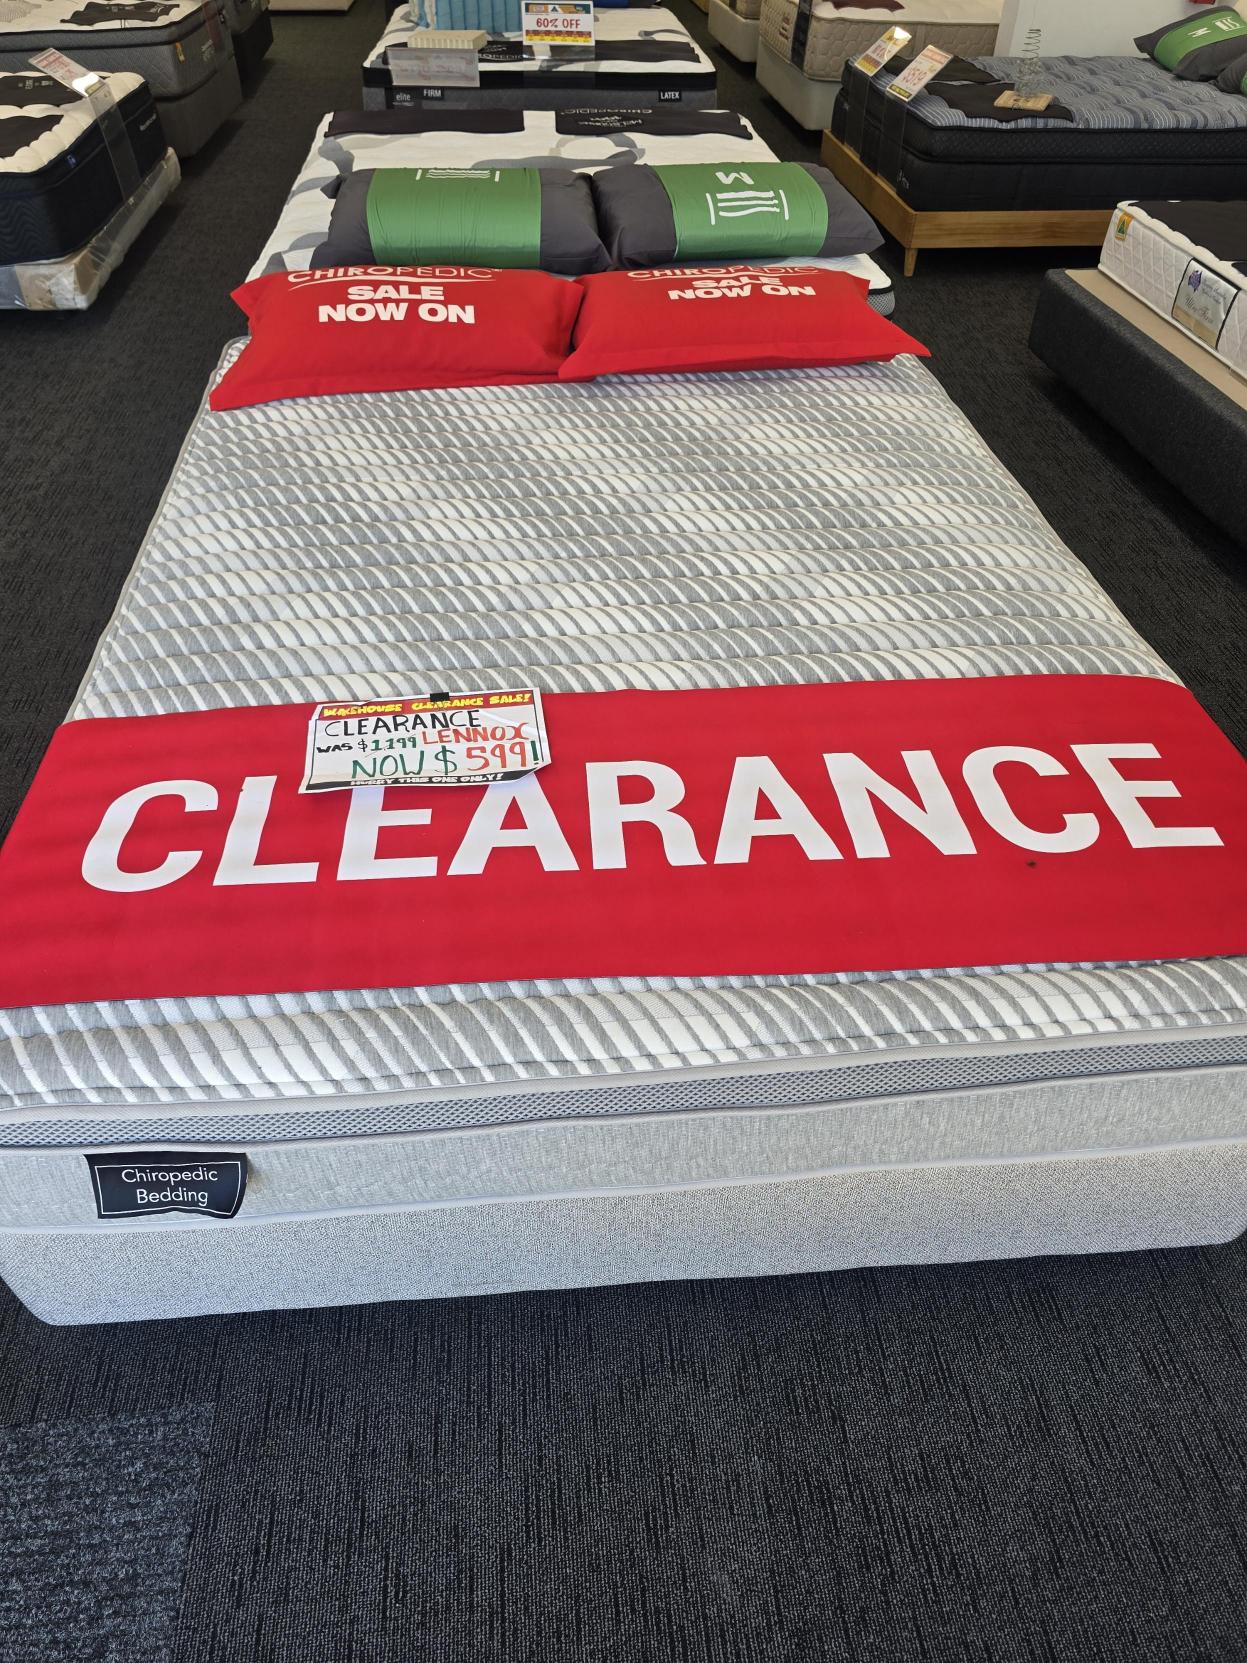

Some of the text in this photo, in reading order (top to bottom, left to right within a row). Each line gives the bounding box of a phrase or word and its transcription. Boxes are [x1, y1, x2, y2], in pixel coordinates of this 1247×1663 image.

[536, 18, 581, 29] 60% OFF
[423, 88, 442, 97] FIRM
[660, 91, 680, 100] LATEX
[287, 266, 494, 283] CHIROPEDIC
[691, 276, 783, 288] SALE
[347, 285, 445, 301] SALE
[667, 284, 817, 300] NOW ON
[318, 302, 476, 324] NOW ON
[411, 697, 484, 711] CLEARANCE
[489, 693, 532, 705] SALE!
[324, 709, 482, 737] CLEARANCE
[422, 722, 530, 744] LENNOX
[316, 742, 354, 753] WAS
[351, 750, 425, 779] NOW
[398, 776, 430, 784] THIS
[460, 772, 504, 783] ONLY!
[81, 743, 1225, 893] CLEARANCE
[121, 1167, 219, 1186] Chiropedic
[136, 1187, 209, 1207] Bedding
